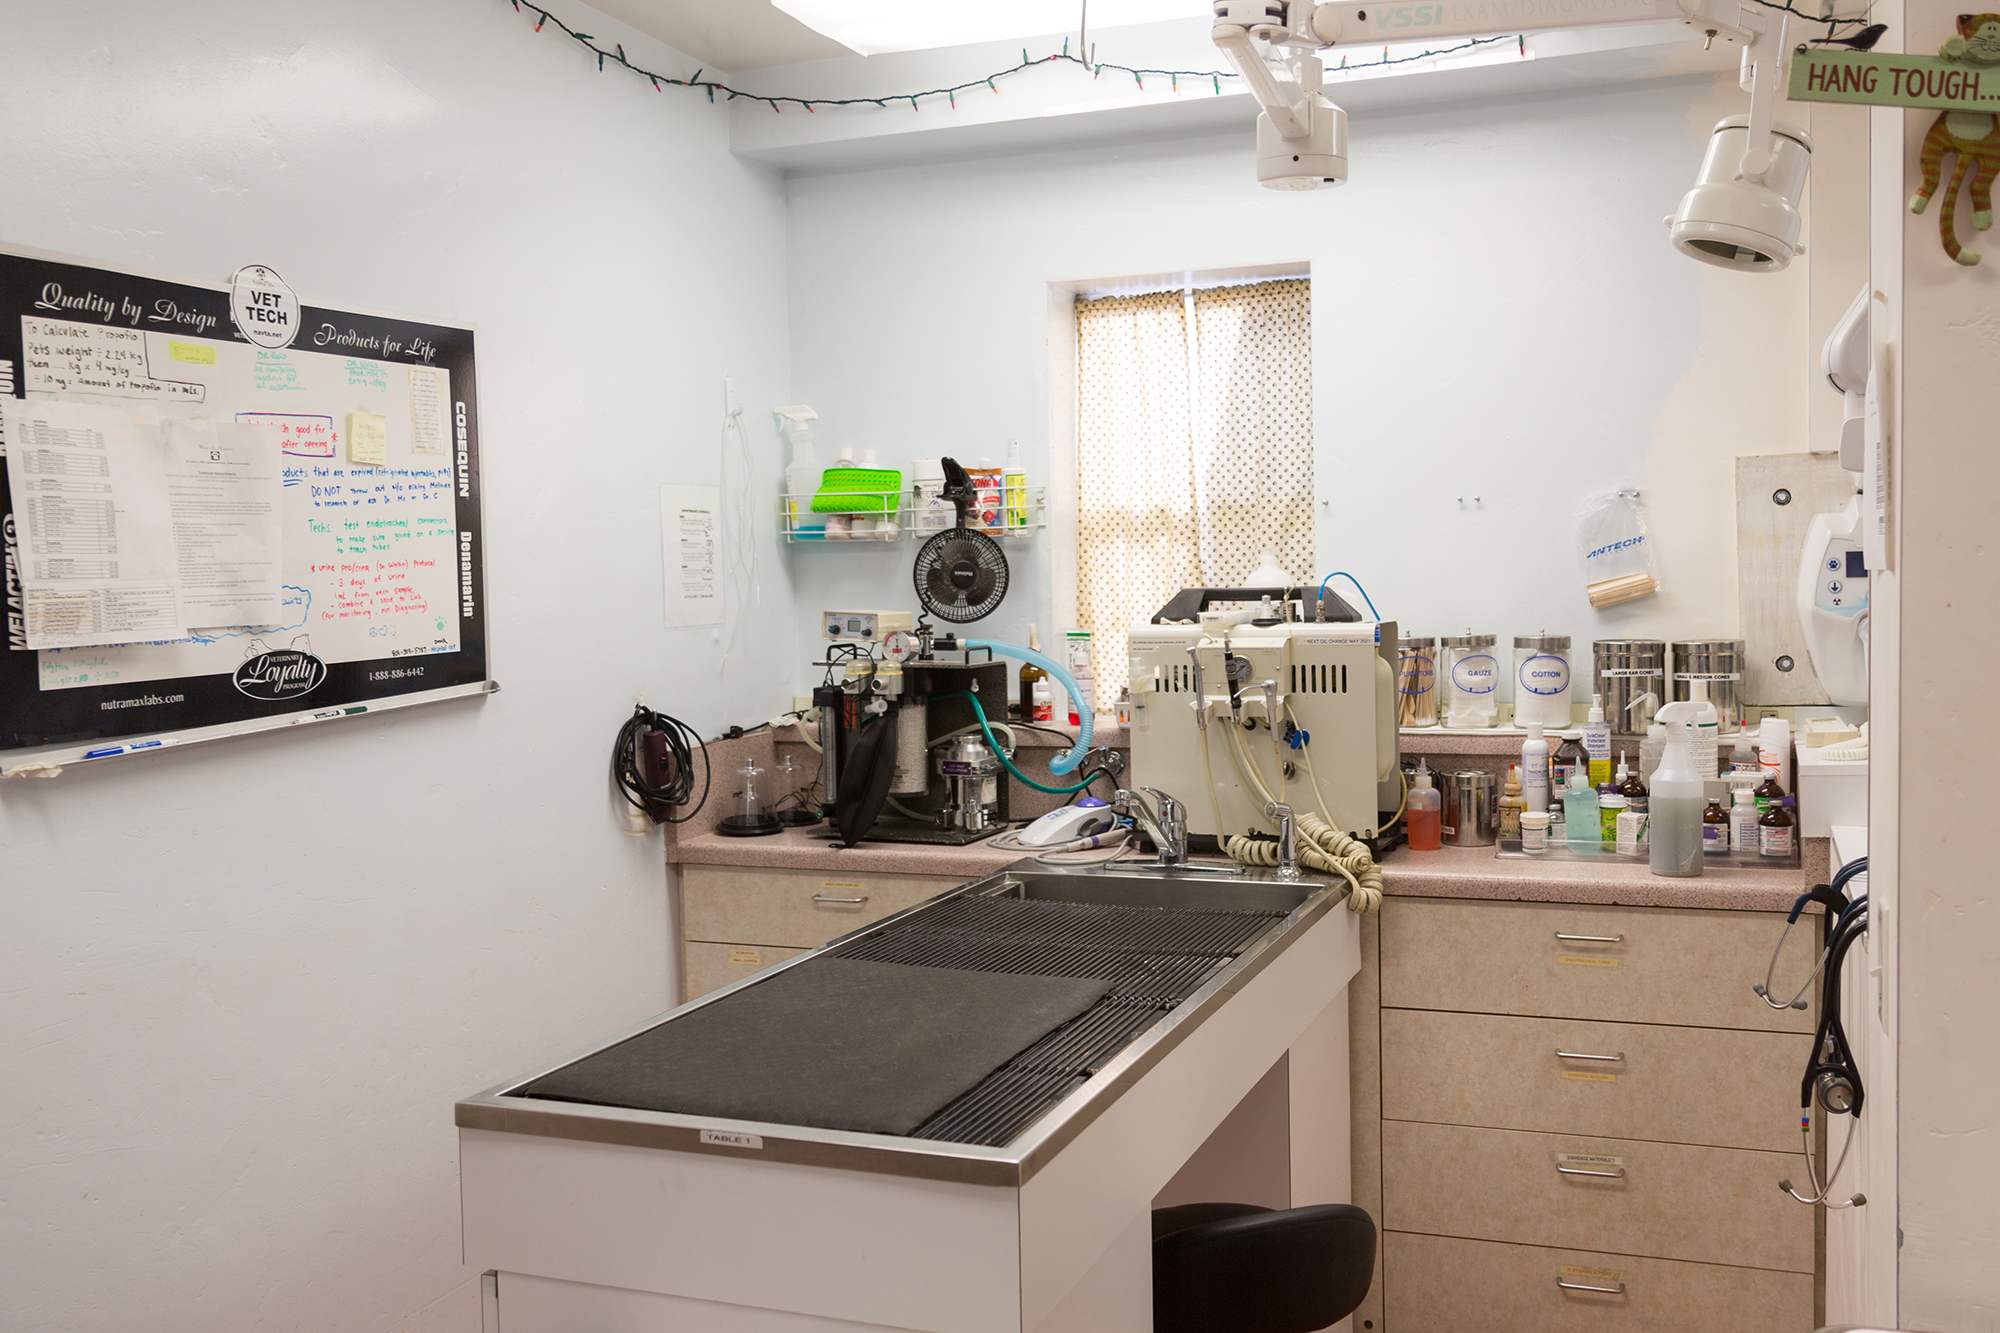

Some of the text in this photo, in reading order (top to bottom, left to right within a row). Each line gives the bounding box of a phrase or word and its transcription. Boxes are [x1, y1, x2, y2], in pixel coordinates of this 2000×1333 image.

[1374, 5, 1442, 28] VSSI
[1808, 63, 2000, 101] HANG TOUGH...
[34, 282, 217, 333] Quality by Design
[251, 290, 281, 308] VET
[246, 306, 288, 325] TECH
[253, 330, 283, 339] navta.net
[314, 323, 437, 362] Products for Life
[56, 345, 92, 361] weight
[455, 401, 470, 497] COSEQUIN
[313, 465, 329, 477] that
[311, 485, 321, 497] DO
[324, 485, 341, 496] NOT
[1586, 535, 1646, 560] ANTECH
[461, 532, 474, 617] Denamarin
[239, 654, 317, 694] Loyalty
[369, 666, 425, 681] 1-888-886-6442
[1467, 669, 1492, 677] GAUZE
[1531, 670, 1561, 678] COTTON
[101, 693, 185, 711] nutramaxlabs.com
[708, 1134, 741, 1144] TABLE
